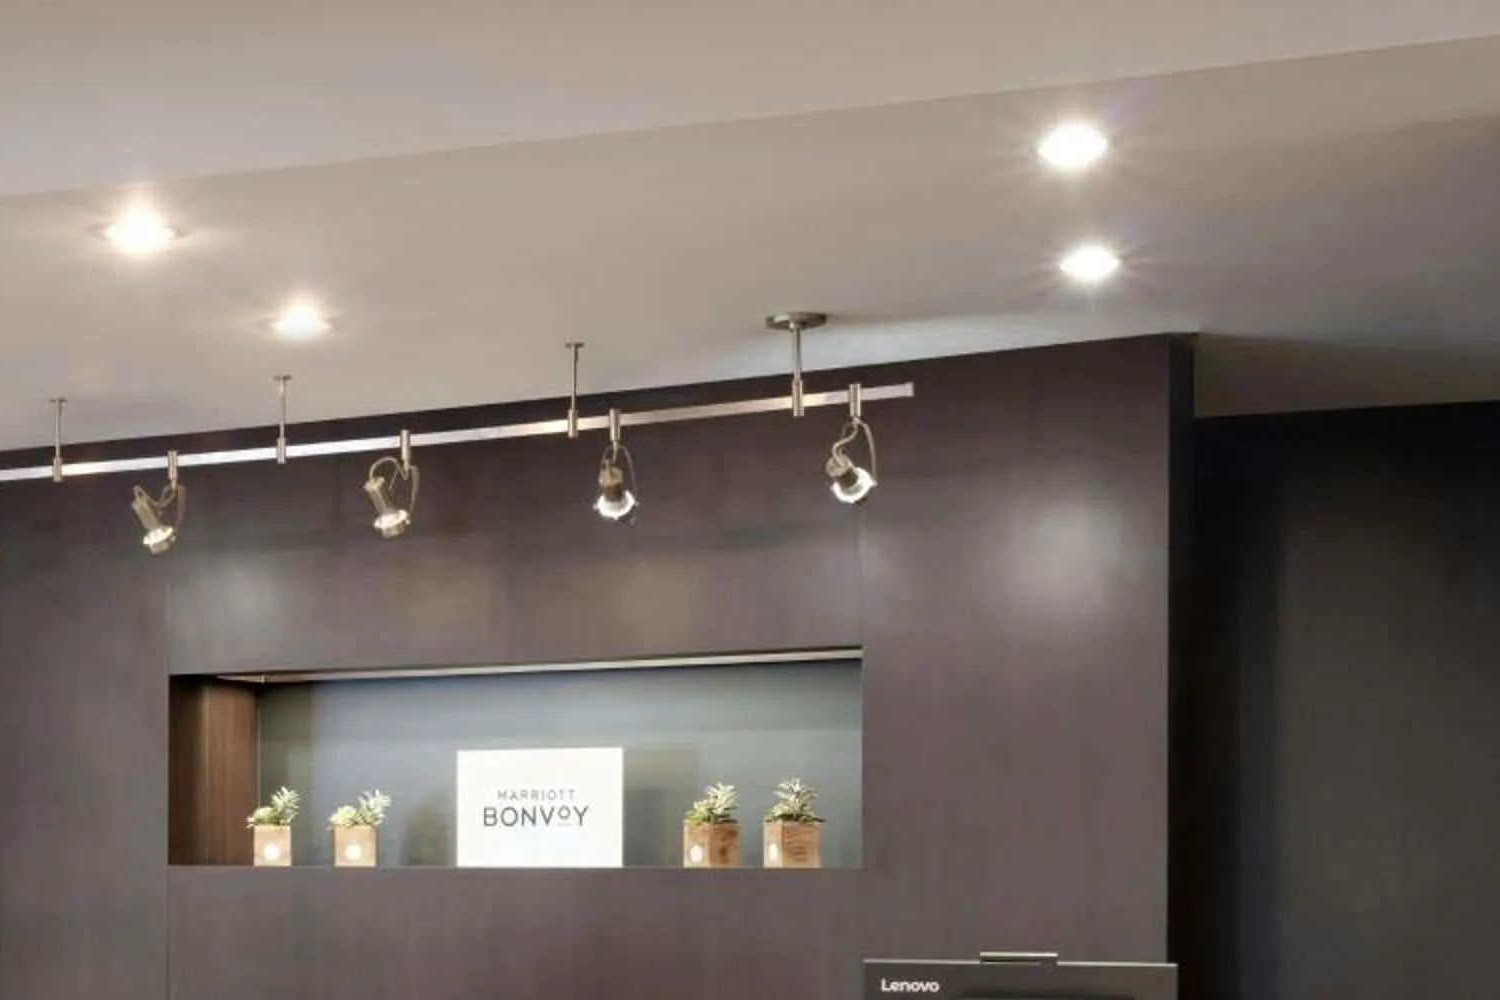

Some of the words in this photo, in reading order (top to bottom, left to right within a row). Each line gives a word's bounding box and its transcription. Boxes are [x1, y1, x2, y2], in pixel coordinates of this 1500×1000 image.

[497, 789, 576, 801] MARRIOTT
[483, 805, 589, 827] BONVOY
[881, 978, 940, 993] Lenovo
